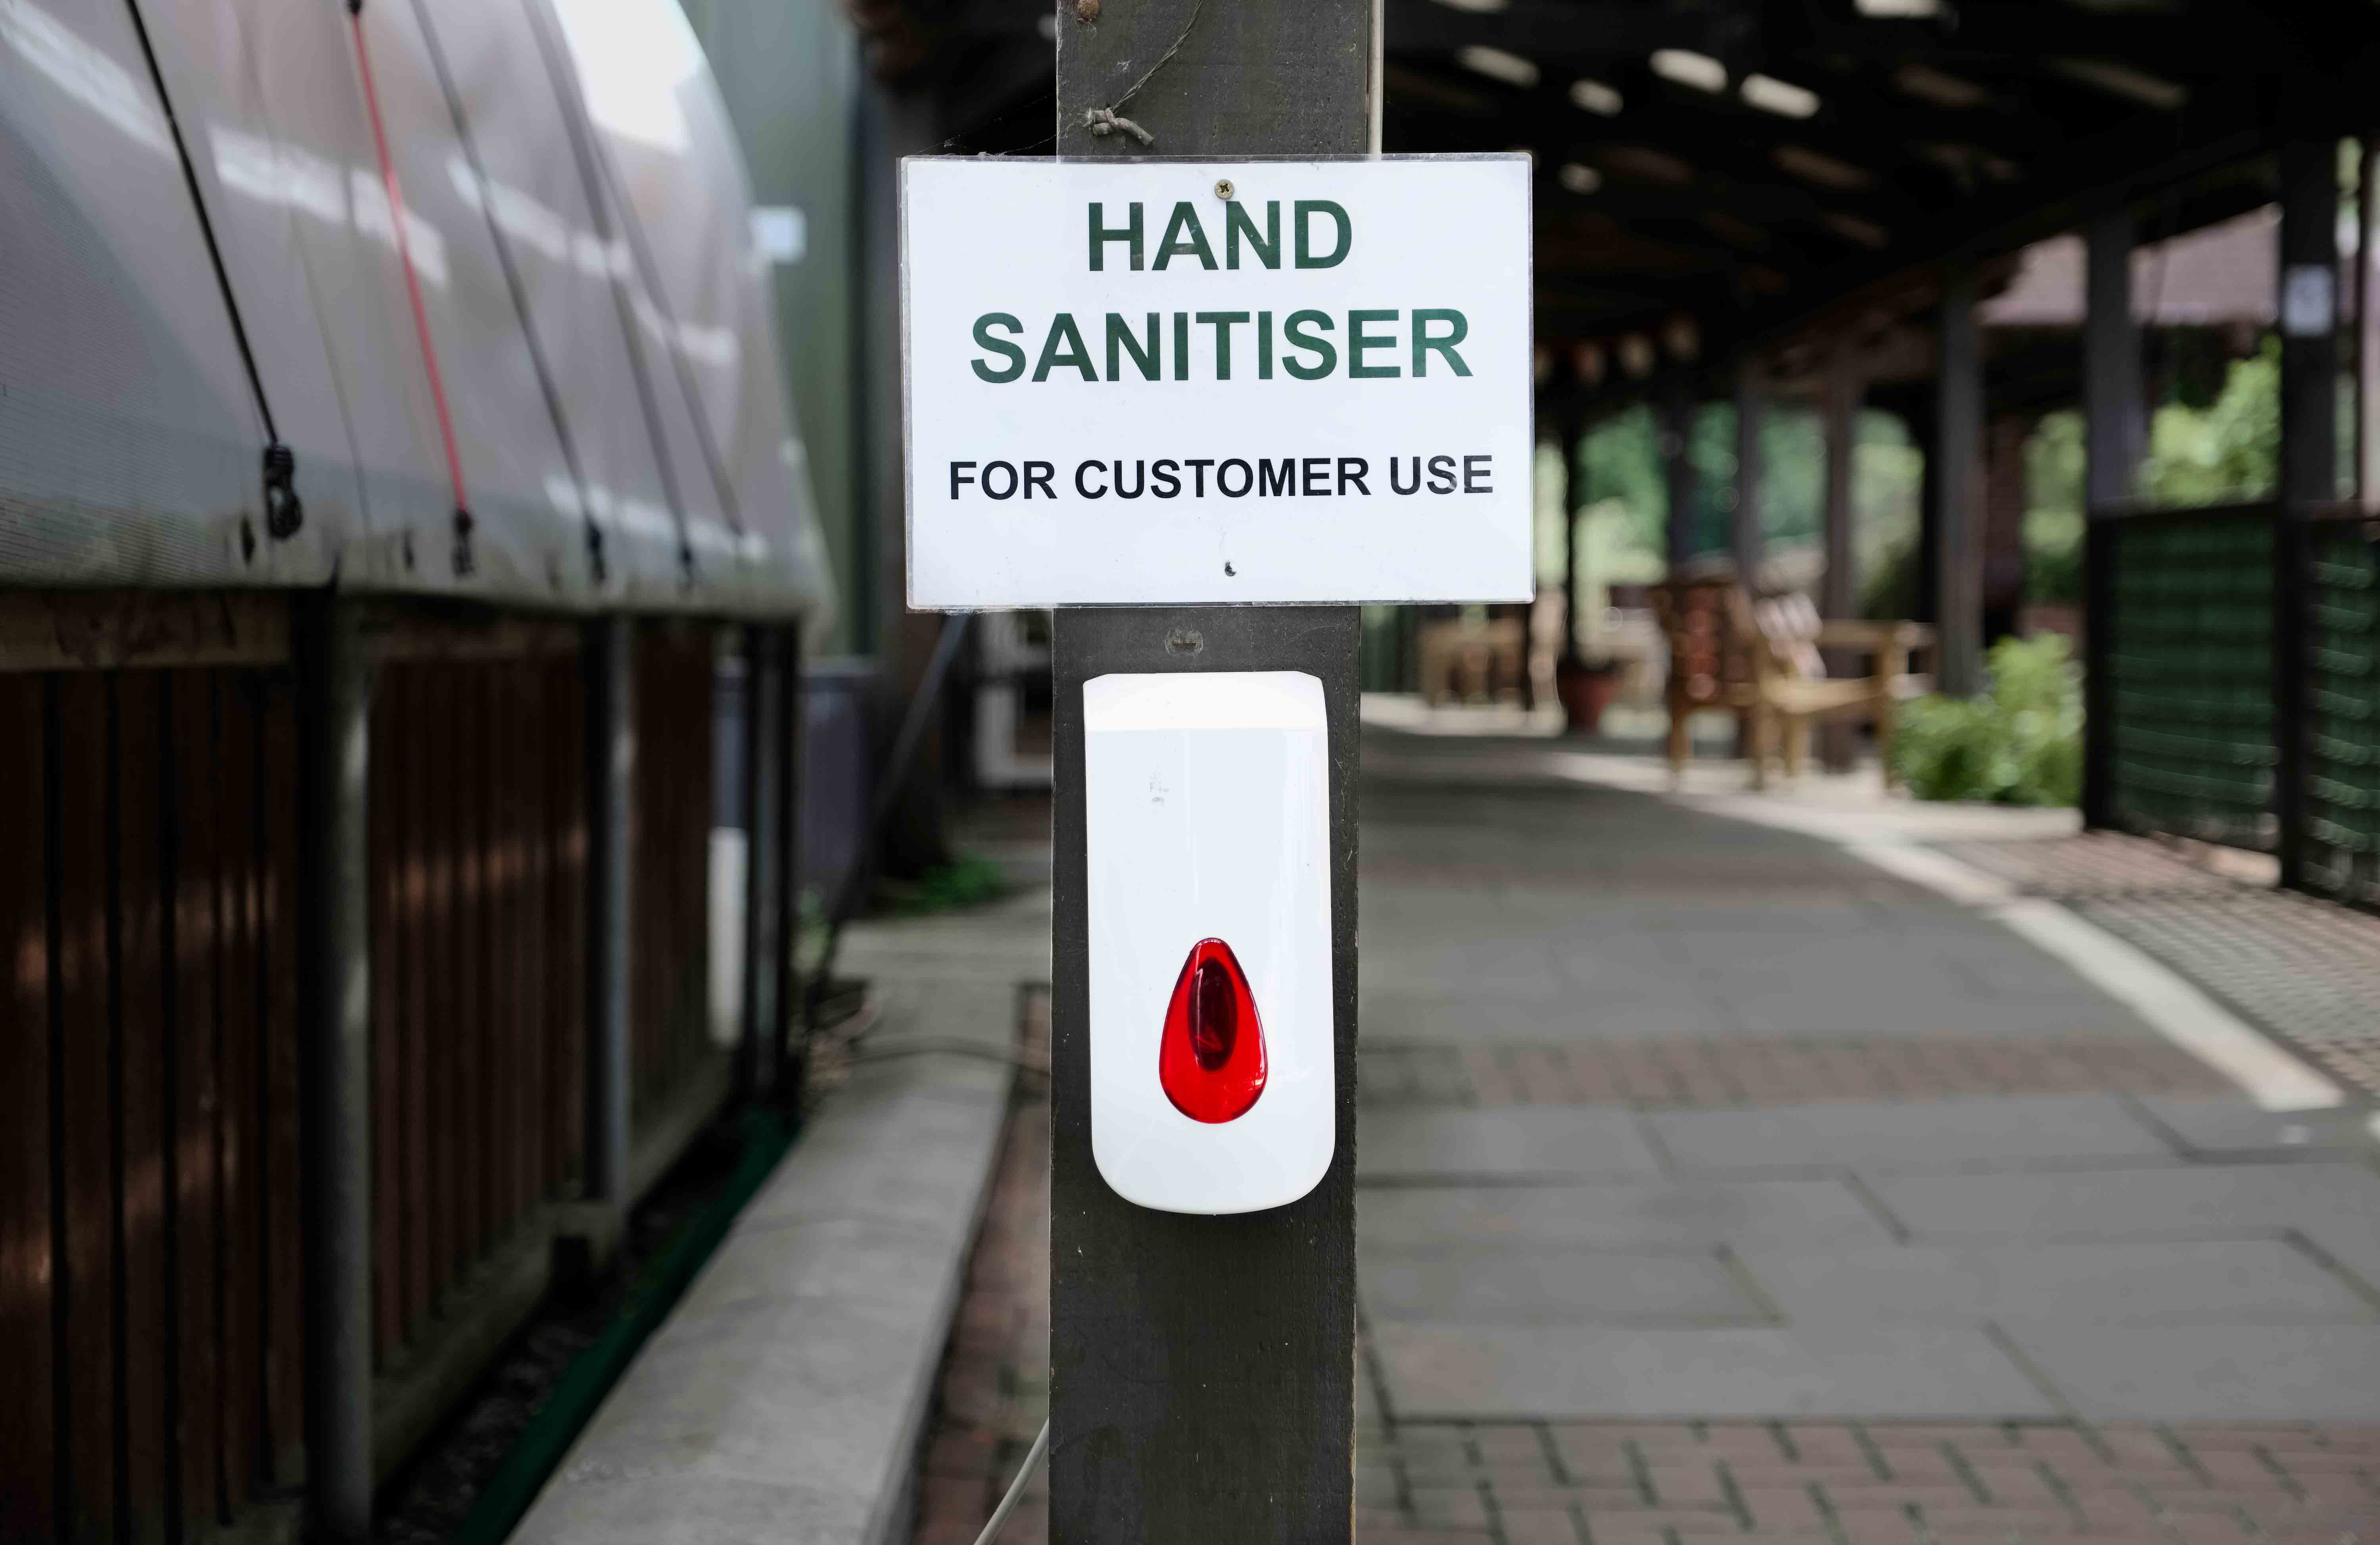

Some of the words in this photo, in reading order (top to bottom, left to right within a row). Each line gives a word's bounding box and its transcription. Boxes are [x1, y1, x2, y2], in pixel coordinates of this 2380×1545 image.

[1088, 199, 1352, 272] HAND
[970, 308, 1473, 384] SANITISER
[950, 460, 1058, 500] FOR
[1075, 457, 1372, 500] CUSTOMER
[1390, 454, 1493, 496] USE
